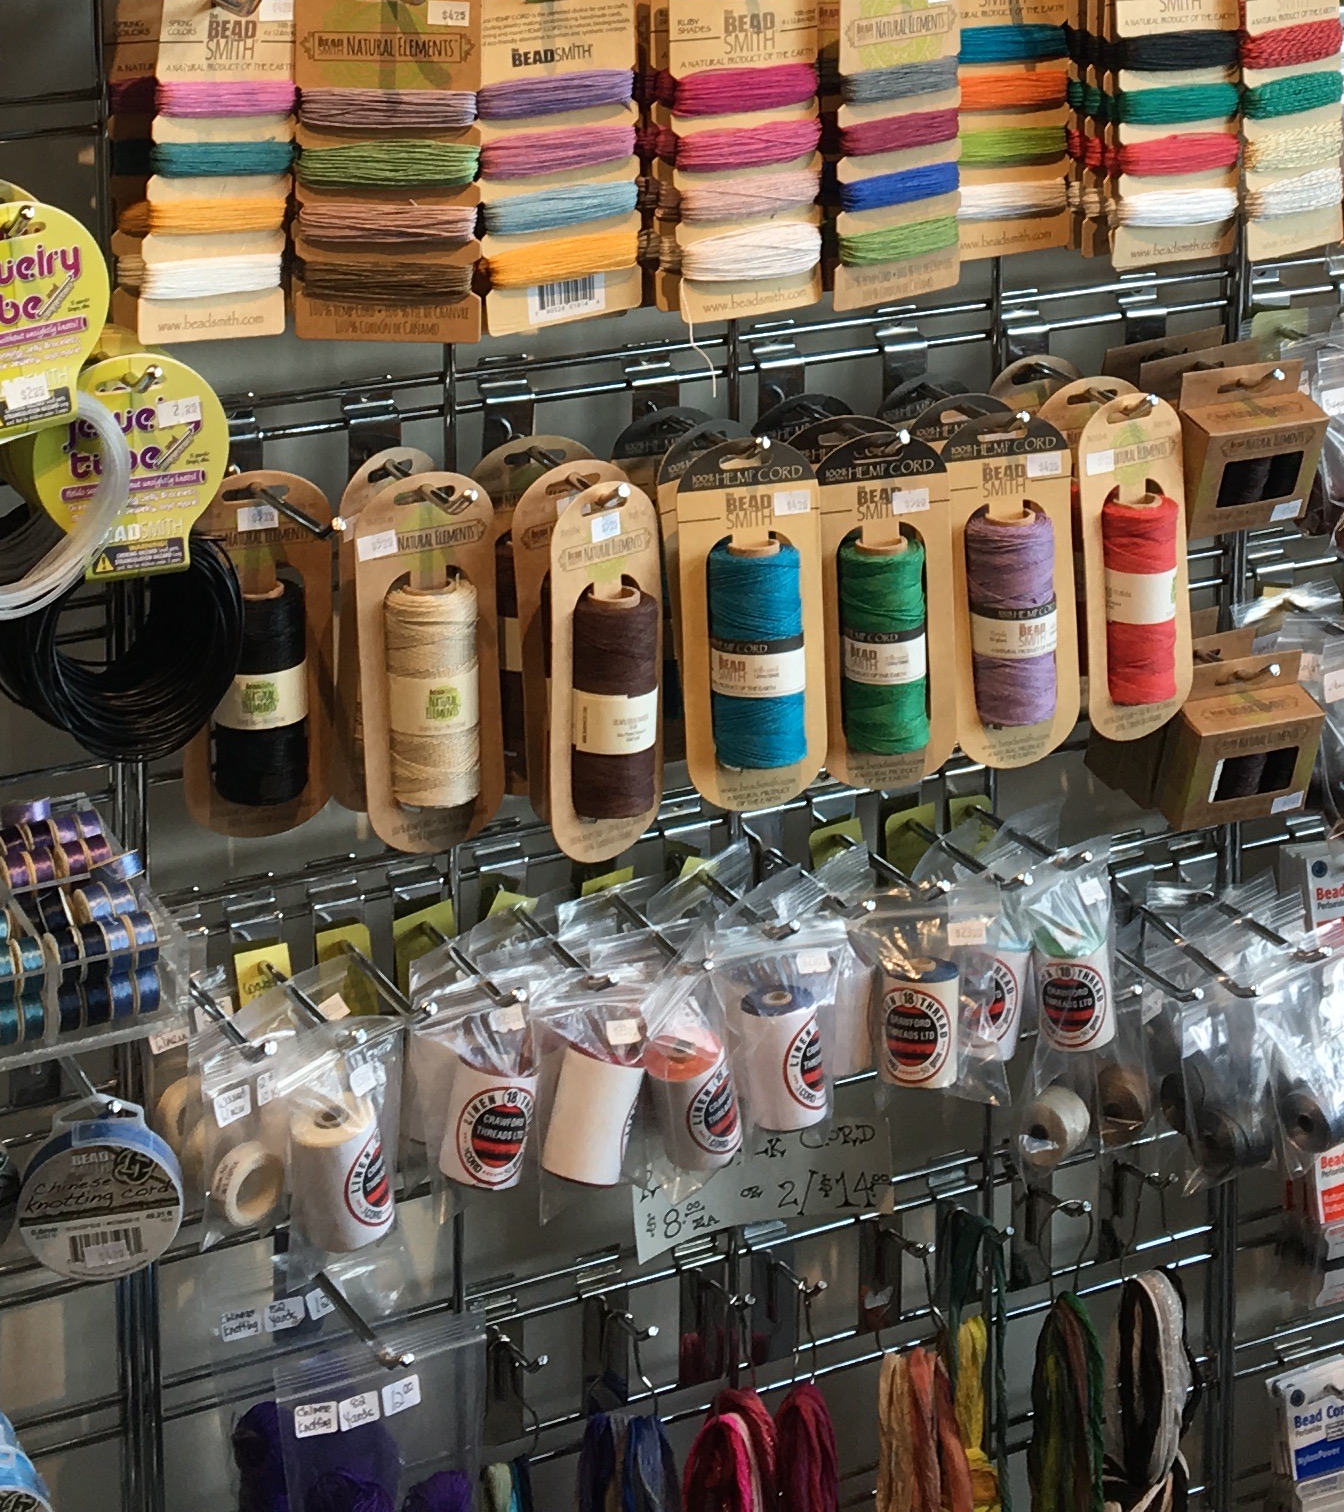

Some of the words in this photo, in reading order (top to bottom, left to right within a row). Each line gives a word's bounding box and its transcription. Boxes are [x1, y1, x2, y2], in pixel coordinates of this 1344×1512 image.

[345, 37, 395, 58] NATURAL
[397, 36, 455, 58] ELEMENTS
[511, 44, 593, 69] BEADSMITH
[1078, 969, 1104, 1003] THREAD
[919, 998, 948, 1039] THREAD
[463, 1094, 496, 1126] LINEN
[506, 1091, 518, 1104] 18
[476, 1126, 512, 1141] THREADS
[1294, 1411, 1324, 1429] Bead
